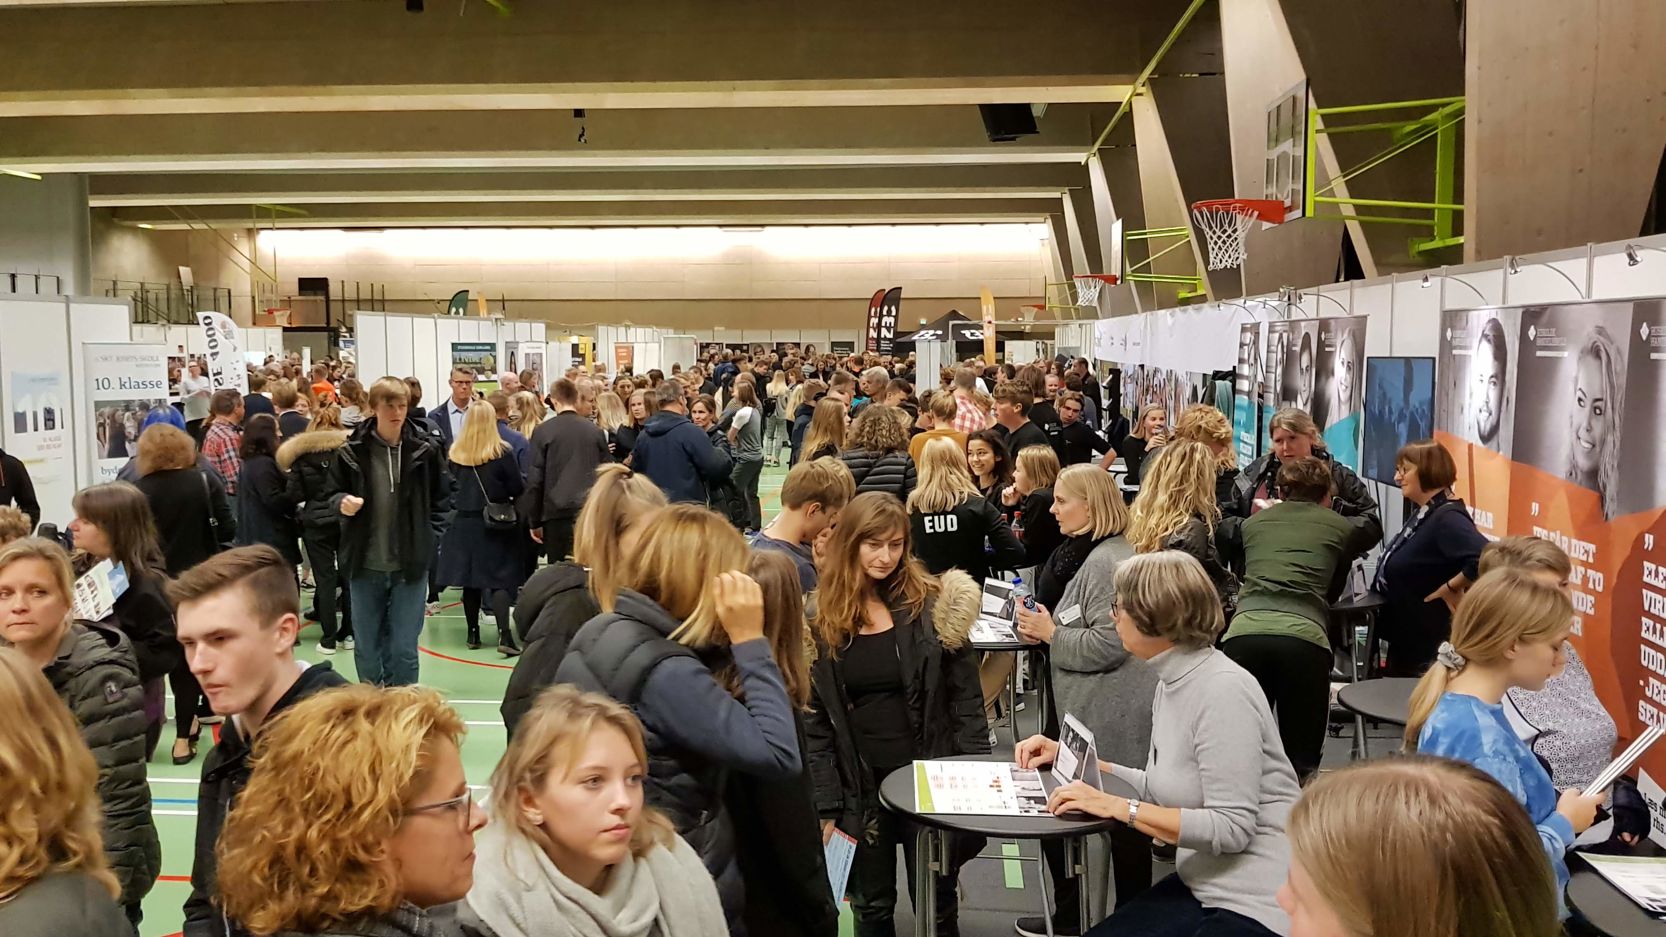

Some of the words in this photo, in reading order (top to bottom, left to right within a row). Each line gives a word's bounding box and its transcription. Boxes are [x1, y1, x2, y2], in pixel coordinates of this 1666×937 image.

[95, 377, 115, 390] 10.
[119, 376, 163, 390] klasse
[924, 515, 957, 533] EUD
[1571, 539, 1596, 563] DET
[1587, 569, 1604, 593] TO
[1640, 643, 1666, 678] UDD
